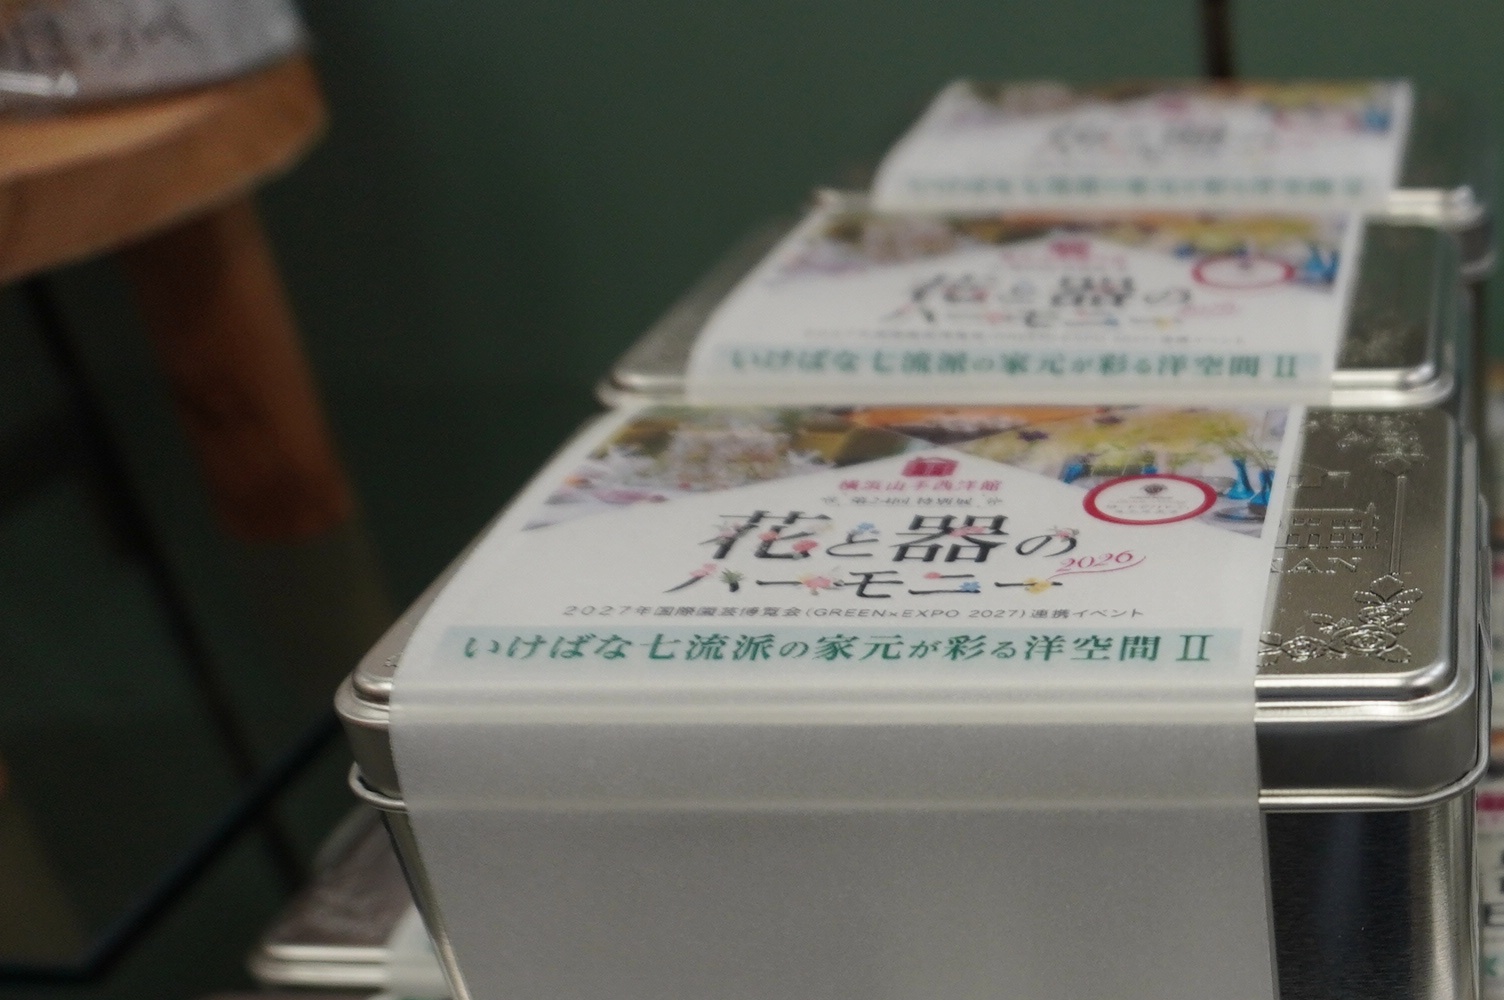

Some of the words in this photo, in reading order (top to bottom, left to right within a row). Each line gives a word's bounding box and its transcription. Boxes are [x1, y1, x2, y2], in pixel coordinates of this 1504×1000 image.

[698, 509, 1080, 563] 花と器の
[1056, 549, 1135, 573] 2026
[663, 563, 1064, 600] ハーモニー
